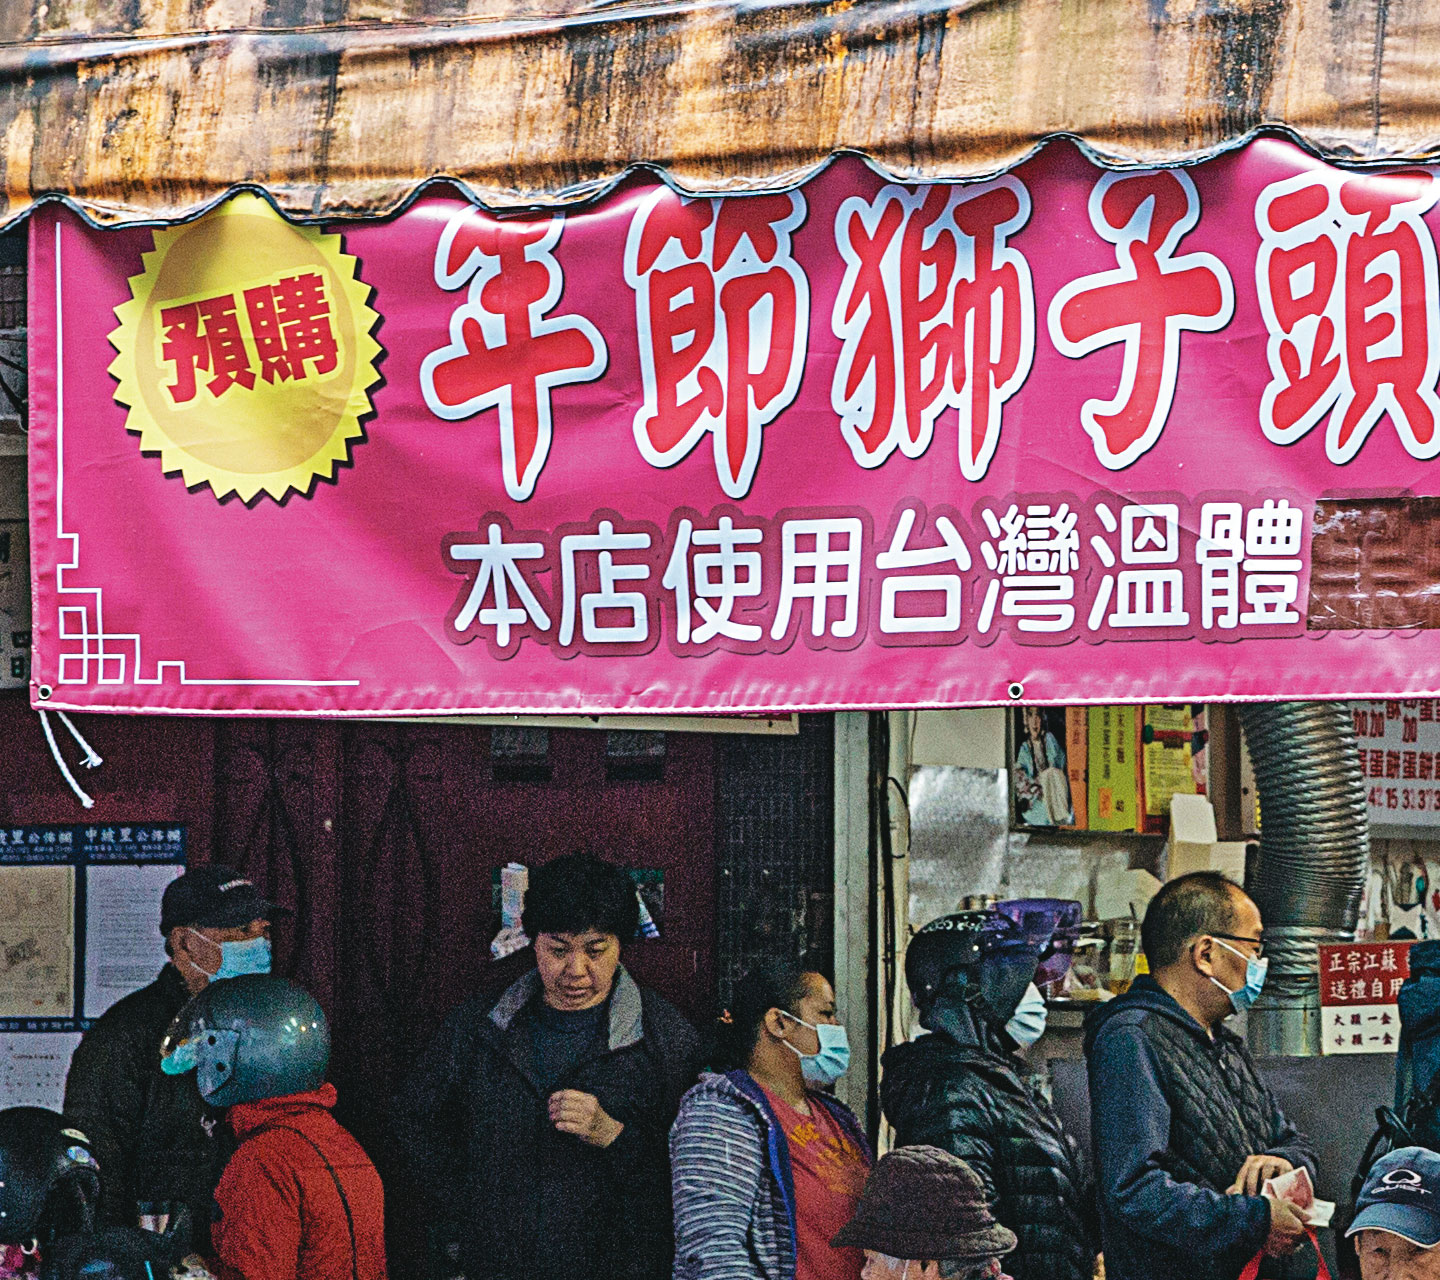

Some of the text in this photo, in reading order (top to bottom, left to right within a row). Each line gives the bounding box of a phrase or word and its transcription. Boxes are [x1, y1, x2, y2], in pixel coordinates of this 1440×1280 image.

[158, 272, 341, 406] 預購
[450, 500, 1304, 648] 本店使用台灣溫體
[1328, 949, 1410, 973] 正宗江蘇
